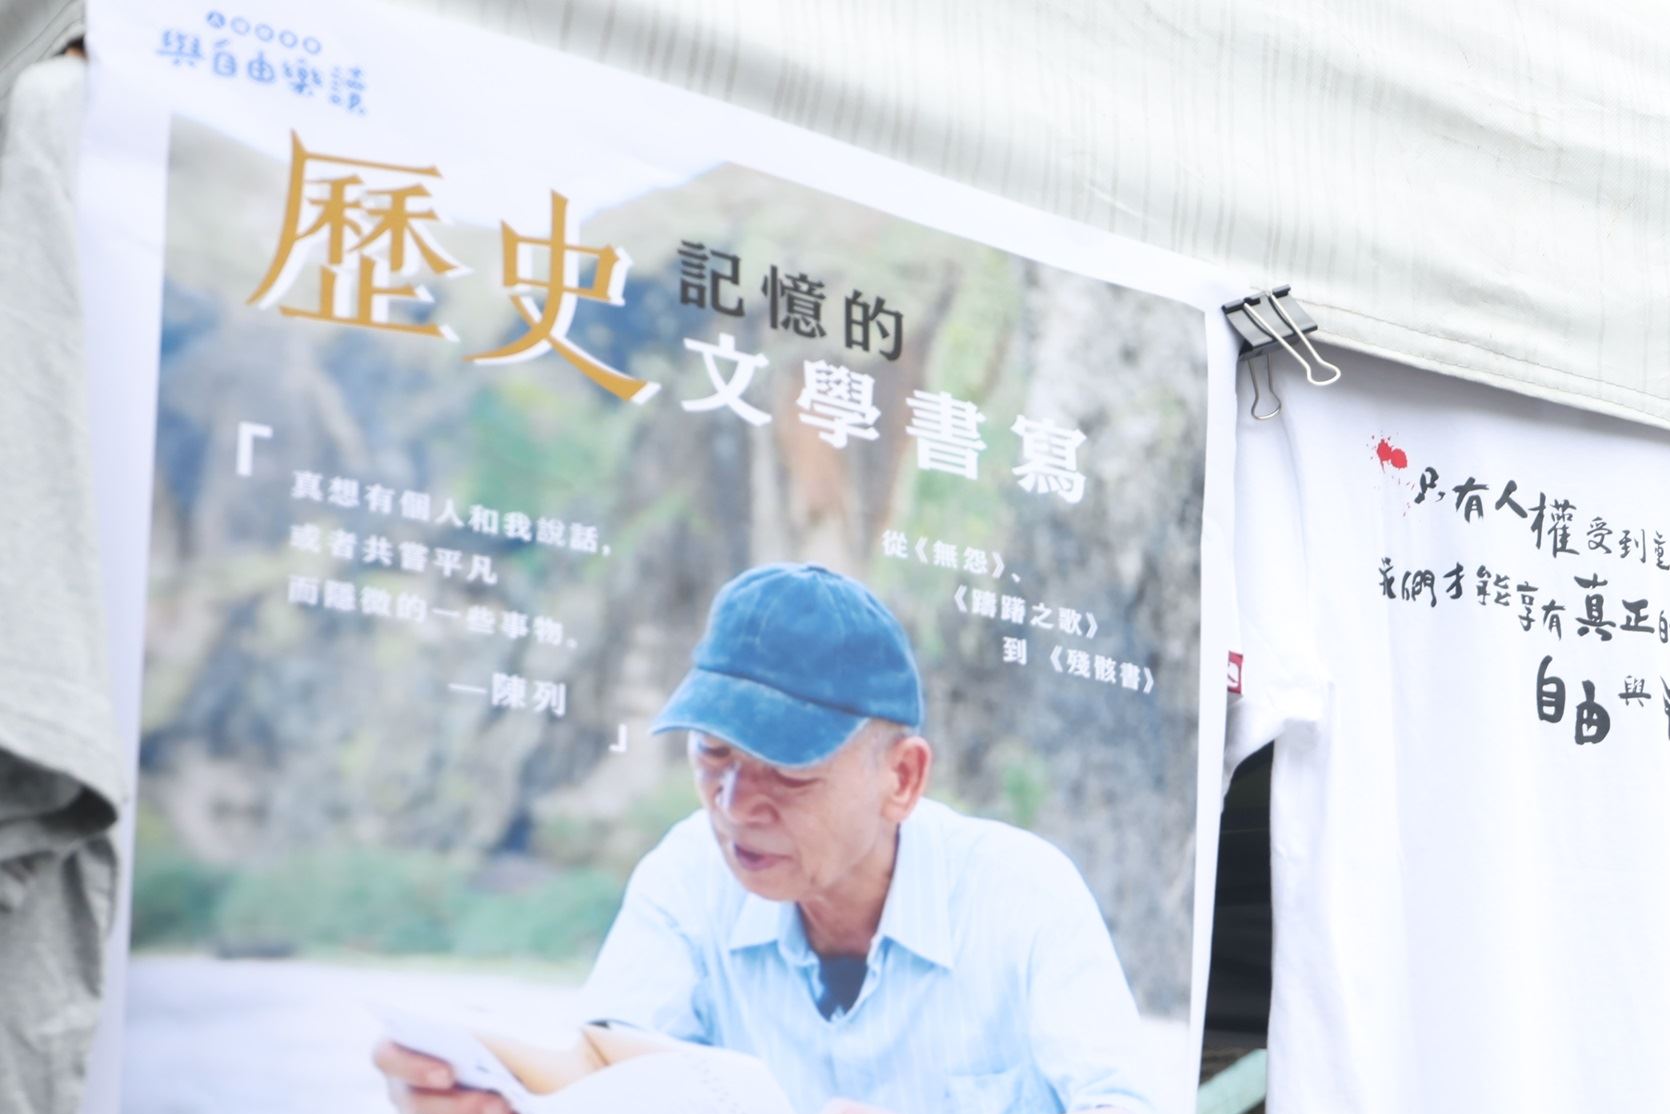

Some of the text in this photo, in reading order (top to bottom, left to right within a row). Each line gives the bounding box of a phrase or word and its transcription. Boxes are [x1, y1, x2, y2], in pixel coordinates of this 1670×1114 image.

[245, 128, 660, 404] 歷史
[677, 240, 904, 361] 記憶的
[681, 333, 1088, 504] 文學書寫
[1003, 637, 1027, 665] 到
